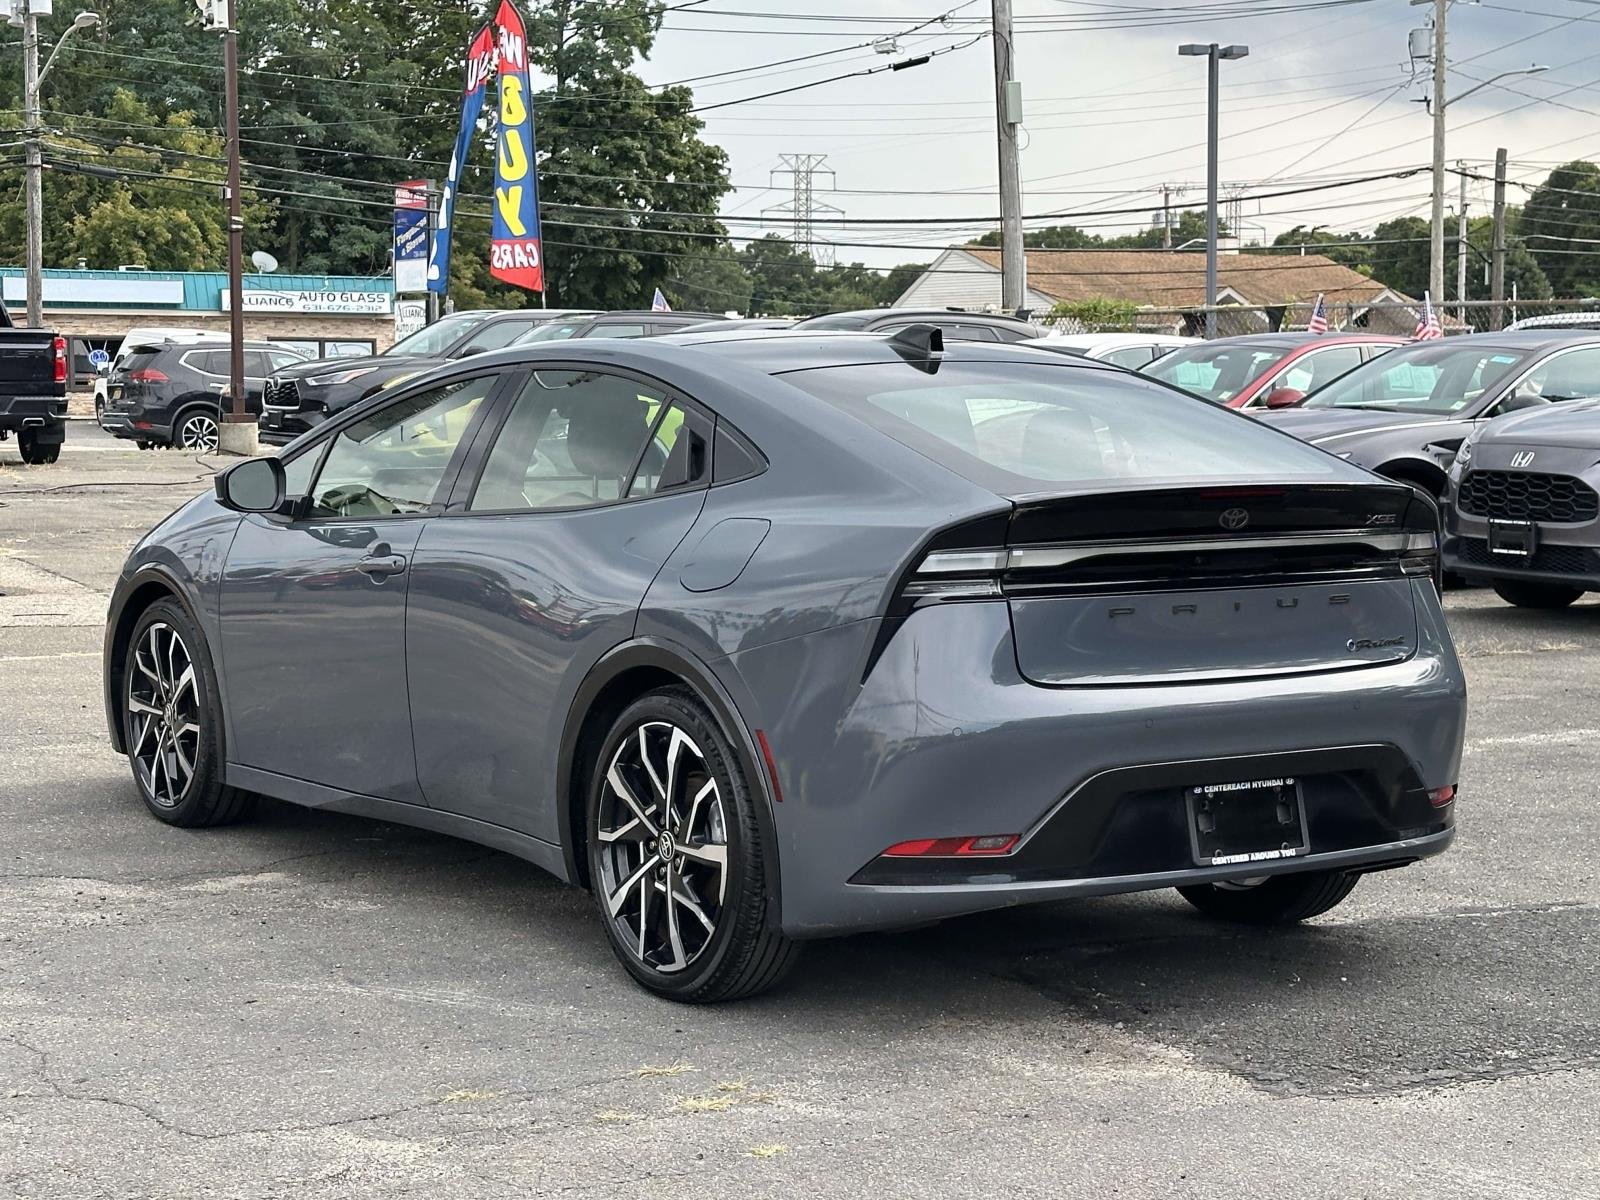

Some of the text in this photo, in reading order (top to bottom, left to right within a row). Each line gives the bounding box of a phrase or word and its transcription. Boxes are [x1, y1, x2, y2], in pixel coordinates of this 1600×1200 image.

[299, 291, 385, 303] AUTO GLASS
[1365, 514, 1396, 525] XSE
[1109, 594, 1350, 619] PRIUS
[1204, 778, 1284, 793] CENTEREACH HYUNDAI
